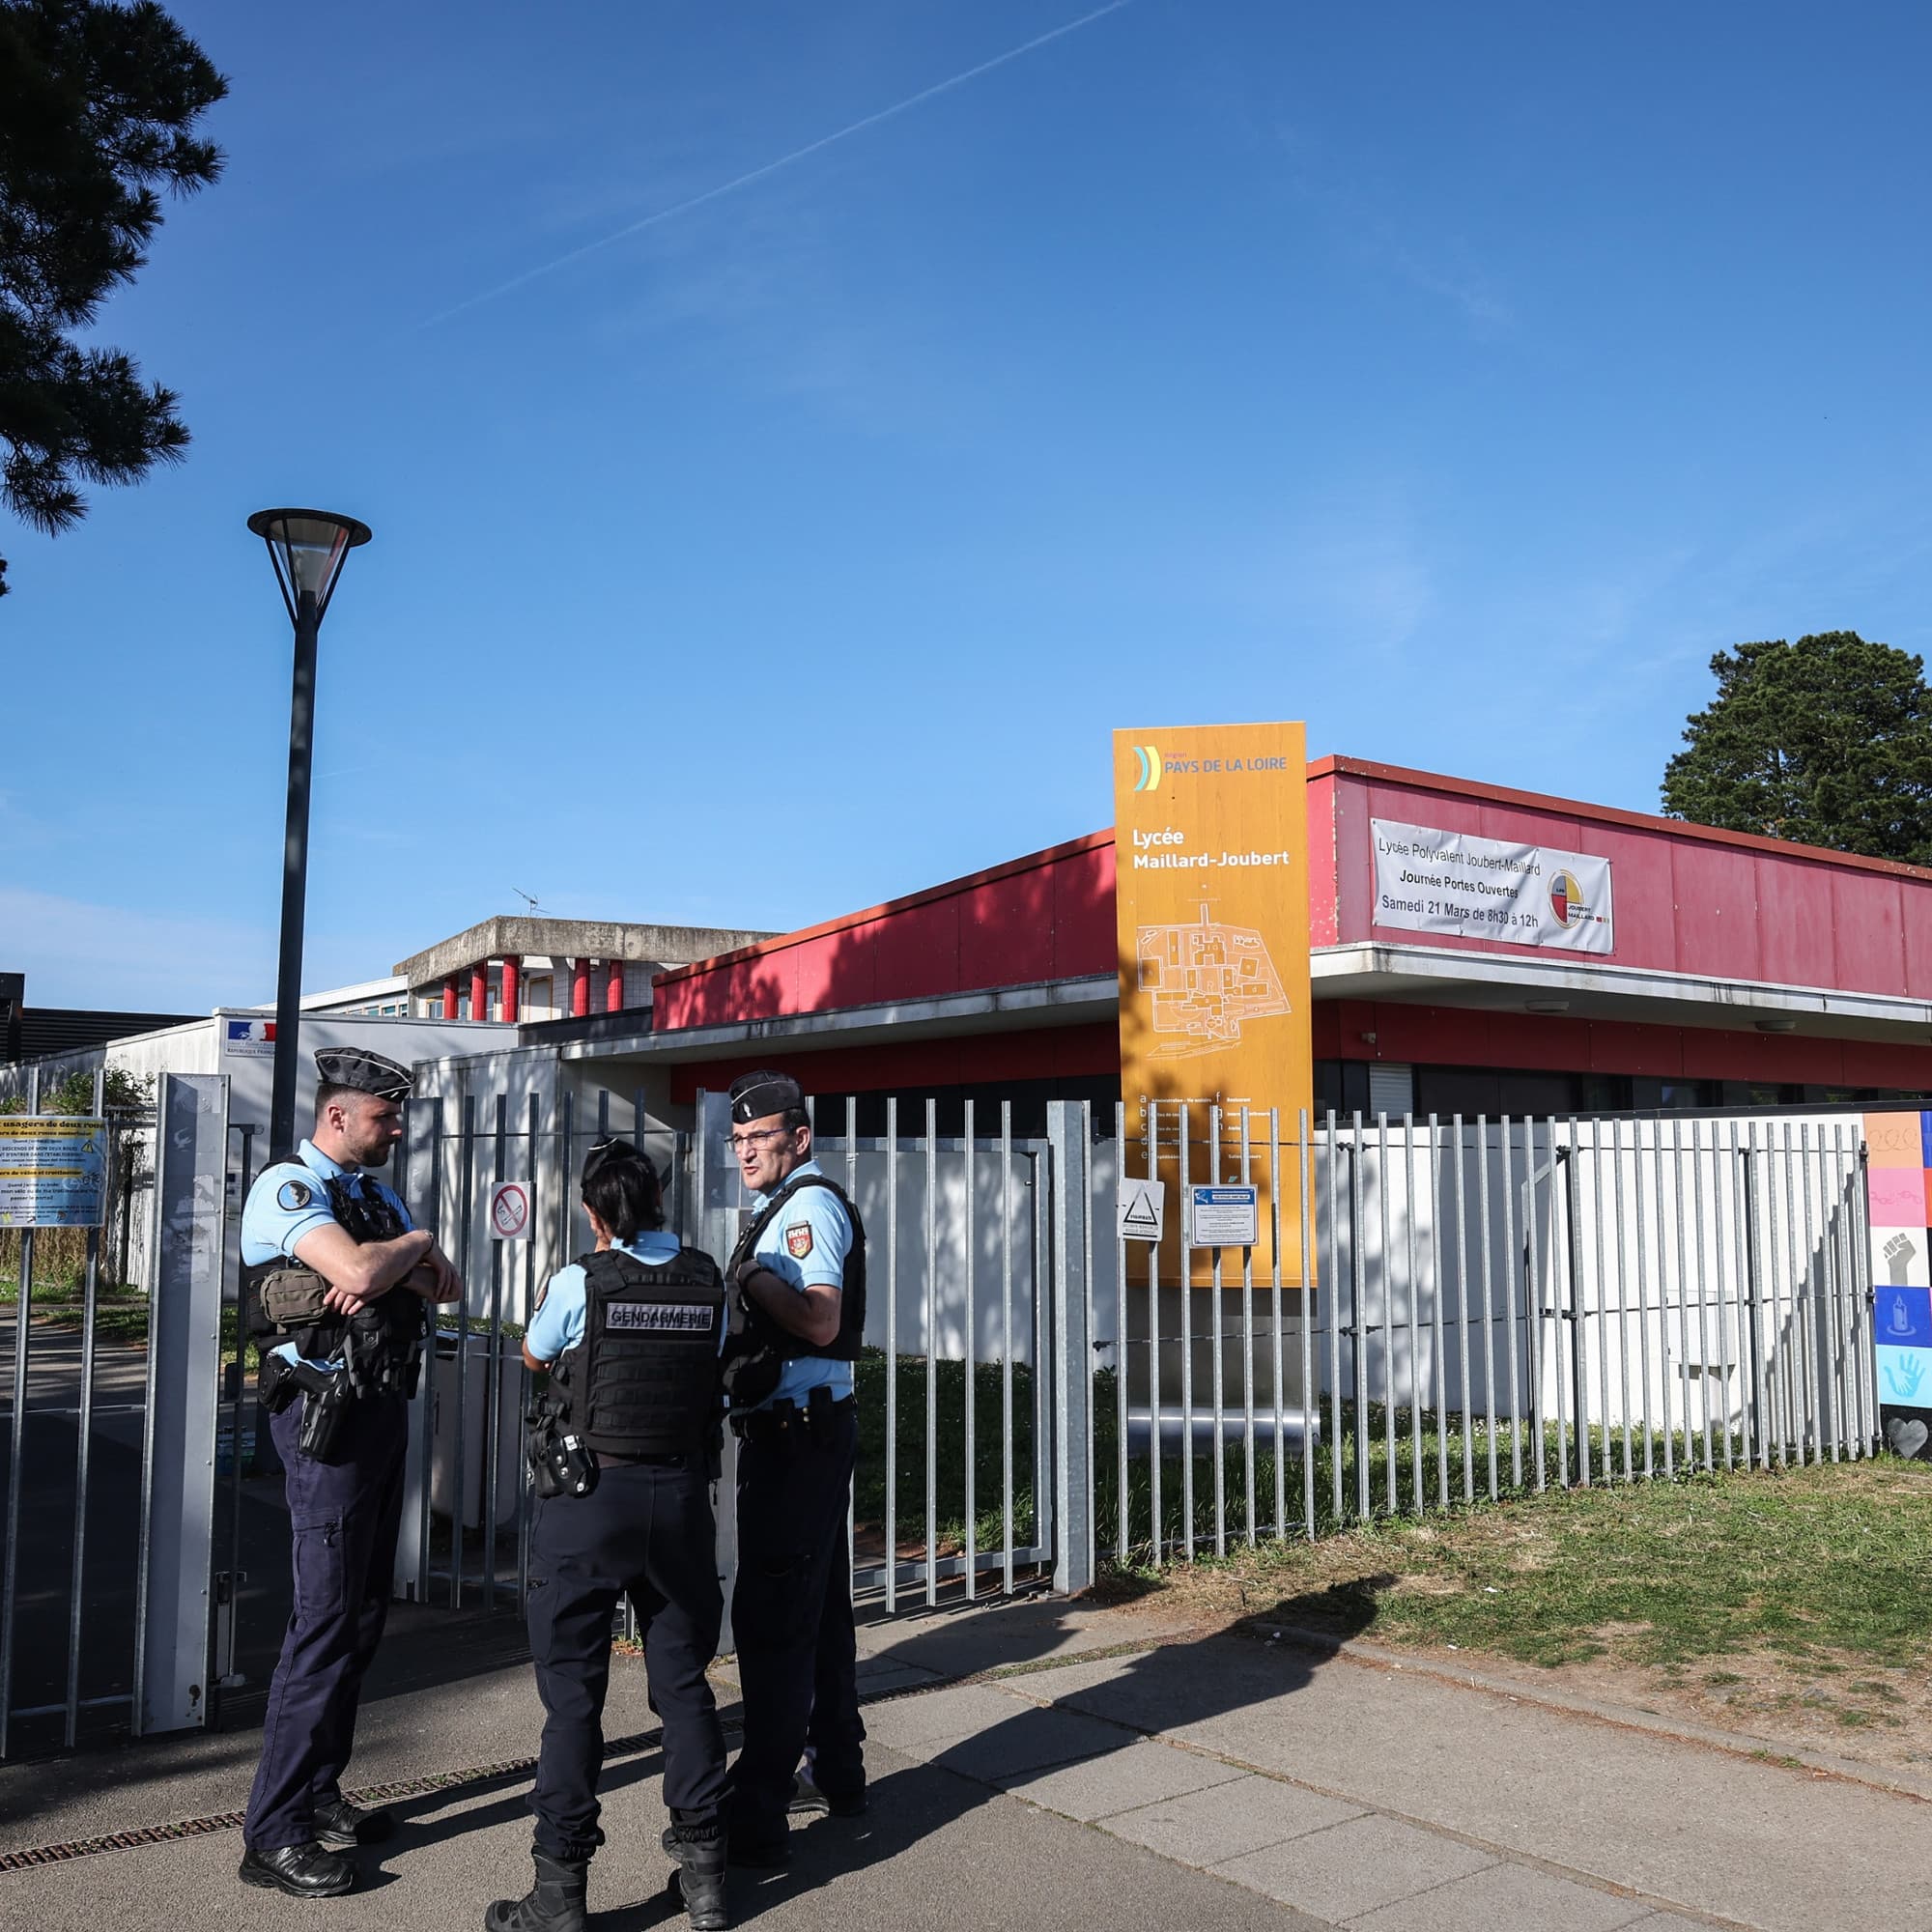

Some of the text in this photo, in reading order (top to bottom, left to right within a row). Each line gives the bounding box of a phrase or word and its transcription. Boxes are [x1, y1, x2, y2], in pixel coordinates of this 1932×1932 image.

[1165, 757, 1287, 773] PAYS DE LA LOIRE
[1133, 827, 1184, 849] Lycée
[1133, 851, 1290, 868] Maillard-Joubert
[1378, 838, 1541, 876] Lycée Polyvalent Joubert-Maillard
[1400, 869, 1519, 899] Journée Portes Ouvertes
[1381, 895, 1539, 927] Samedi 21 Mars de 8h30 à 12h
[1139, 1094, 1147, 1103] a
[1139, 1106, 1147, 1118] b
[611, 1311, 711, 1325] GENDARMERIE
